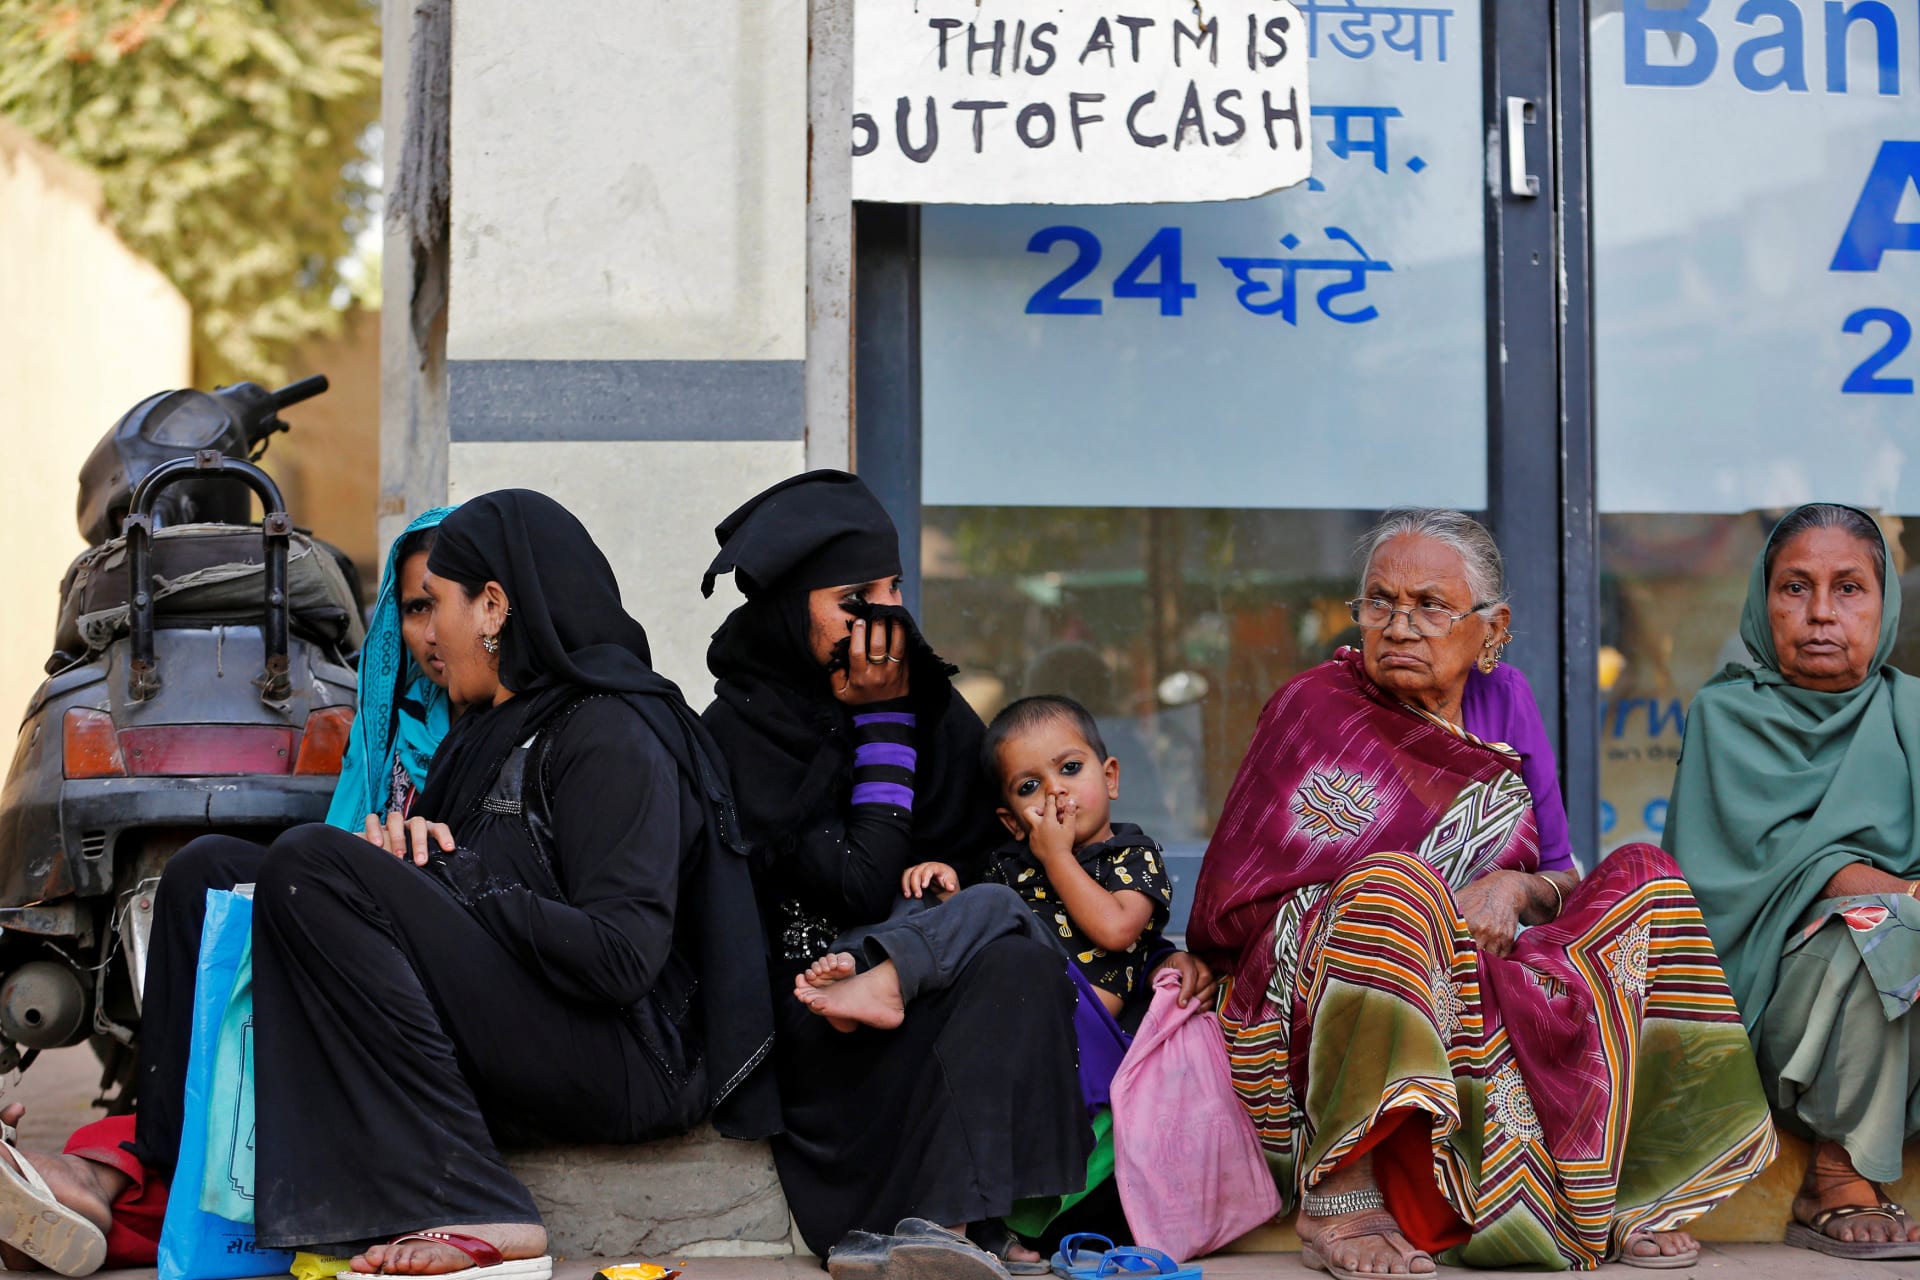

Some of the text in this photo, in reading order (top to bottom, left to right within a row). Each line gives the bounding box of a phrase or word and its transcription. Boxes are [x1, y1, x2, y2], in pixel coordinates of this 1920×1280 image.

[929, 13, 1290, 76] THIS ATM IS
[1302, 0, 1454, 62] डिया
[1624, 0, 1920, 95] Ban
[1016, 92, 1104, 152] OF
[1126, 80, 1302, 151] CASH
[1024, 226, 1393, 327] 24 घंटे
[1841, 307, 1914, 395] 2
